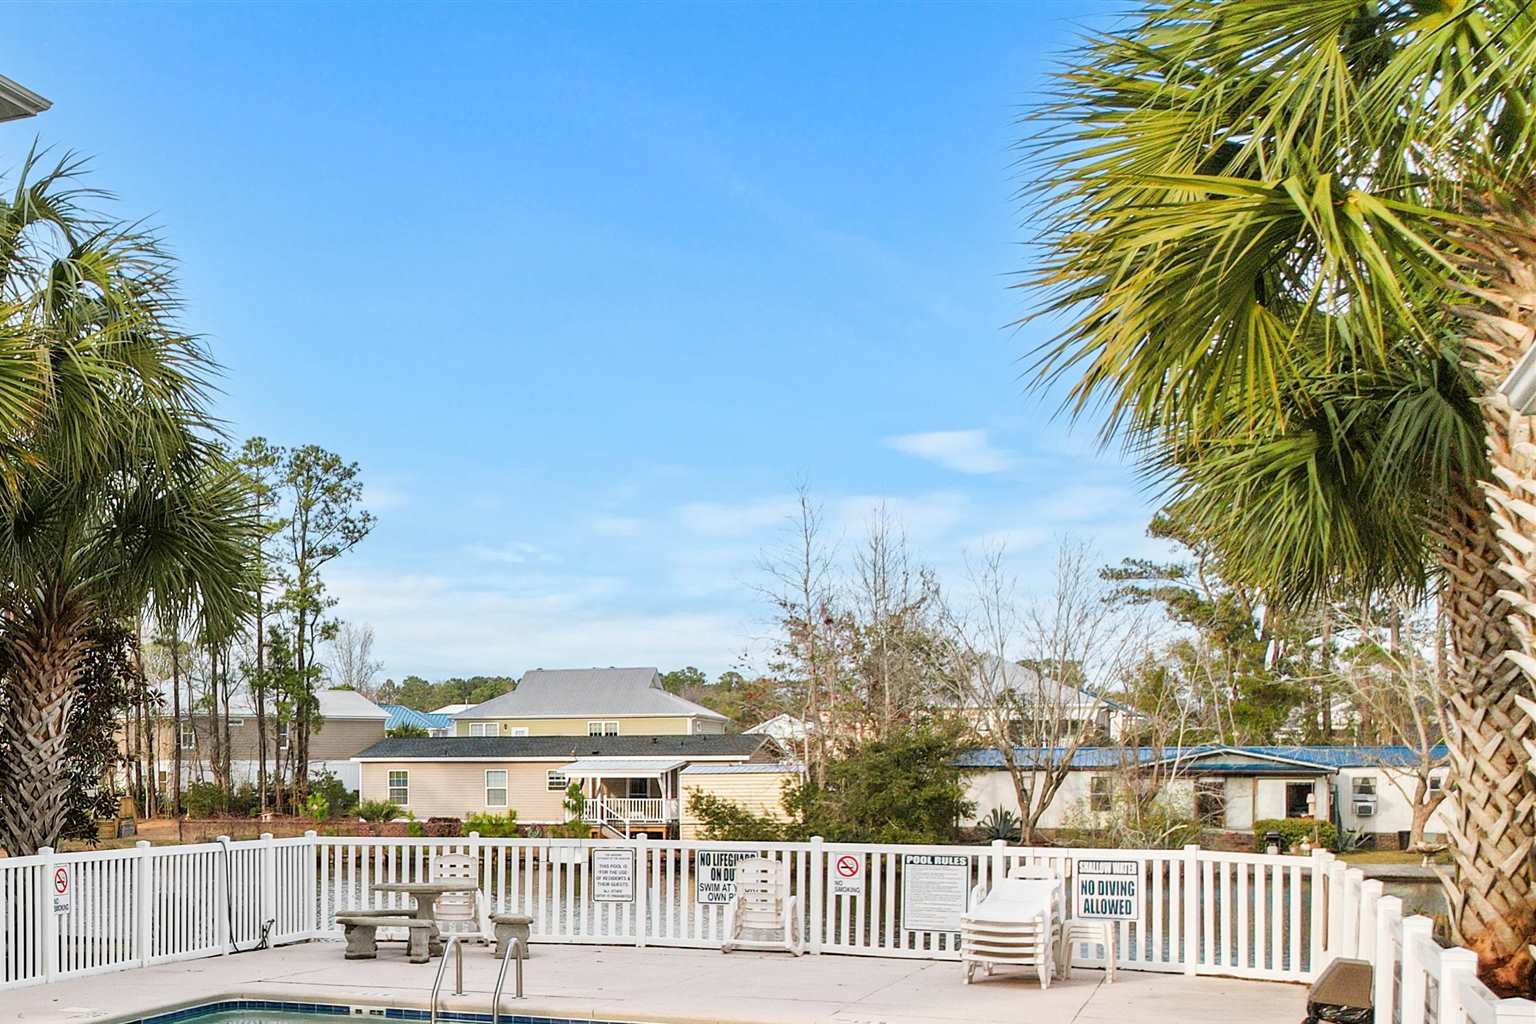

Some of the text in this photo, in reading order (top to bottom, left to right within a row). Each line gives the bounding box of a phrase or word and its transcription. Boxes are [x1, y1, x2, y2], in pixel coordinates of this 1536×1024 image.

[700, 853, 711, 867] NO
[907, 856, 967, 866] POOL RULES
[711, 868, 736, 881] ON DU
[700, 883, 720, 892] SWIM
[722, 883, 731, 892] AT
[1081, 880, 1135, 897] NO DIVING
[708, 892, 727, 902] OWN
[1084, 898, 1132, 915] ALLOWED
